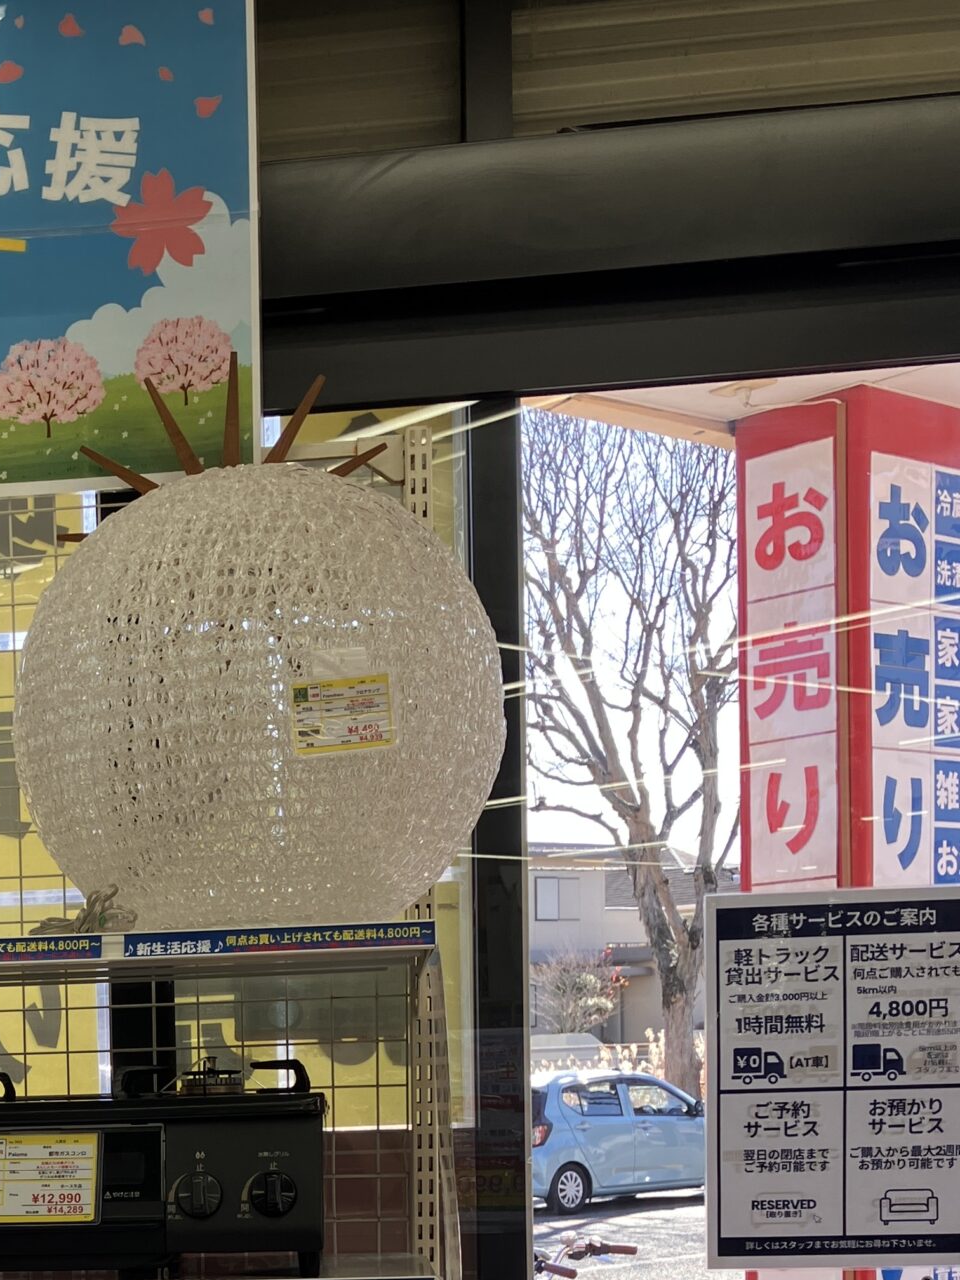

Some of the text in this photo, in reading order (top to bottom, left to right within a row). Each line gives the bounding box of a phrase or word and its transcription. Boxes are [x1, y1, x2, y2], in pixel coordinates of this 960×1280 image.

[752, 907, 937, 932] 各種サービスのご案内
[136, 939, 210, 954] 新生活応援
[850, 941, 960, 964] 配送サービス
[734, 946, 829, 966] 軽トラック
[725, 964, 840, 986] 貸出サービス
[856, 985, 897, 995] 5km以内
[868, 998, 949, 1020] 4,800円
[735, 1013, 825, 1035] 1時間無料
[737, 1055, 760, 1068] ¥0
[754, 1102, 811, 1119] ご予約
[869, 1098, 943, 1117] お預かり
[744, 1120, 819, 1138] サービス
[868, 1117, 944, 1135] サービス
[744, 1149, 830, 1160] 翌日の閉店まで
[744, 1160, 830, 1173] ご予約可能です
[858, 1157, 958, 1170] お預かり可能です
[32, 1193, 81, 1204] ¥12,990
[751, 1199, 817, 1211] RESERVED
[47, 1205, 83, 1215] ¥14,289
